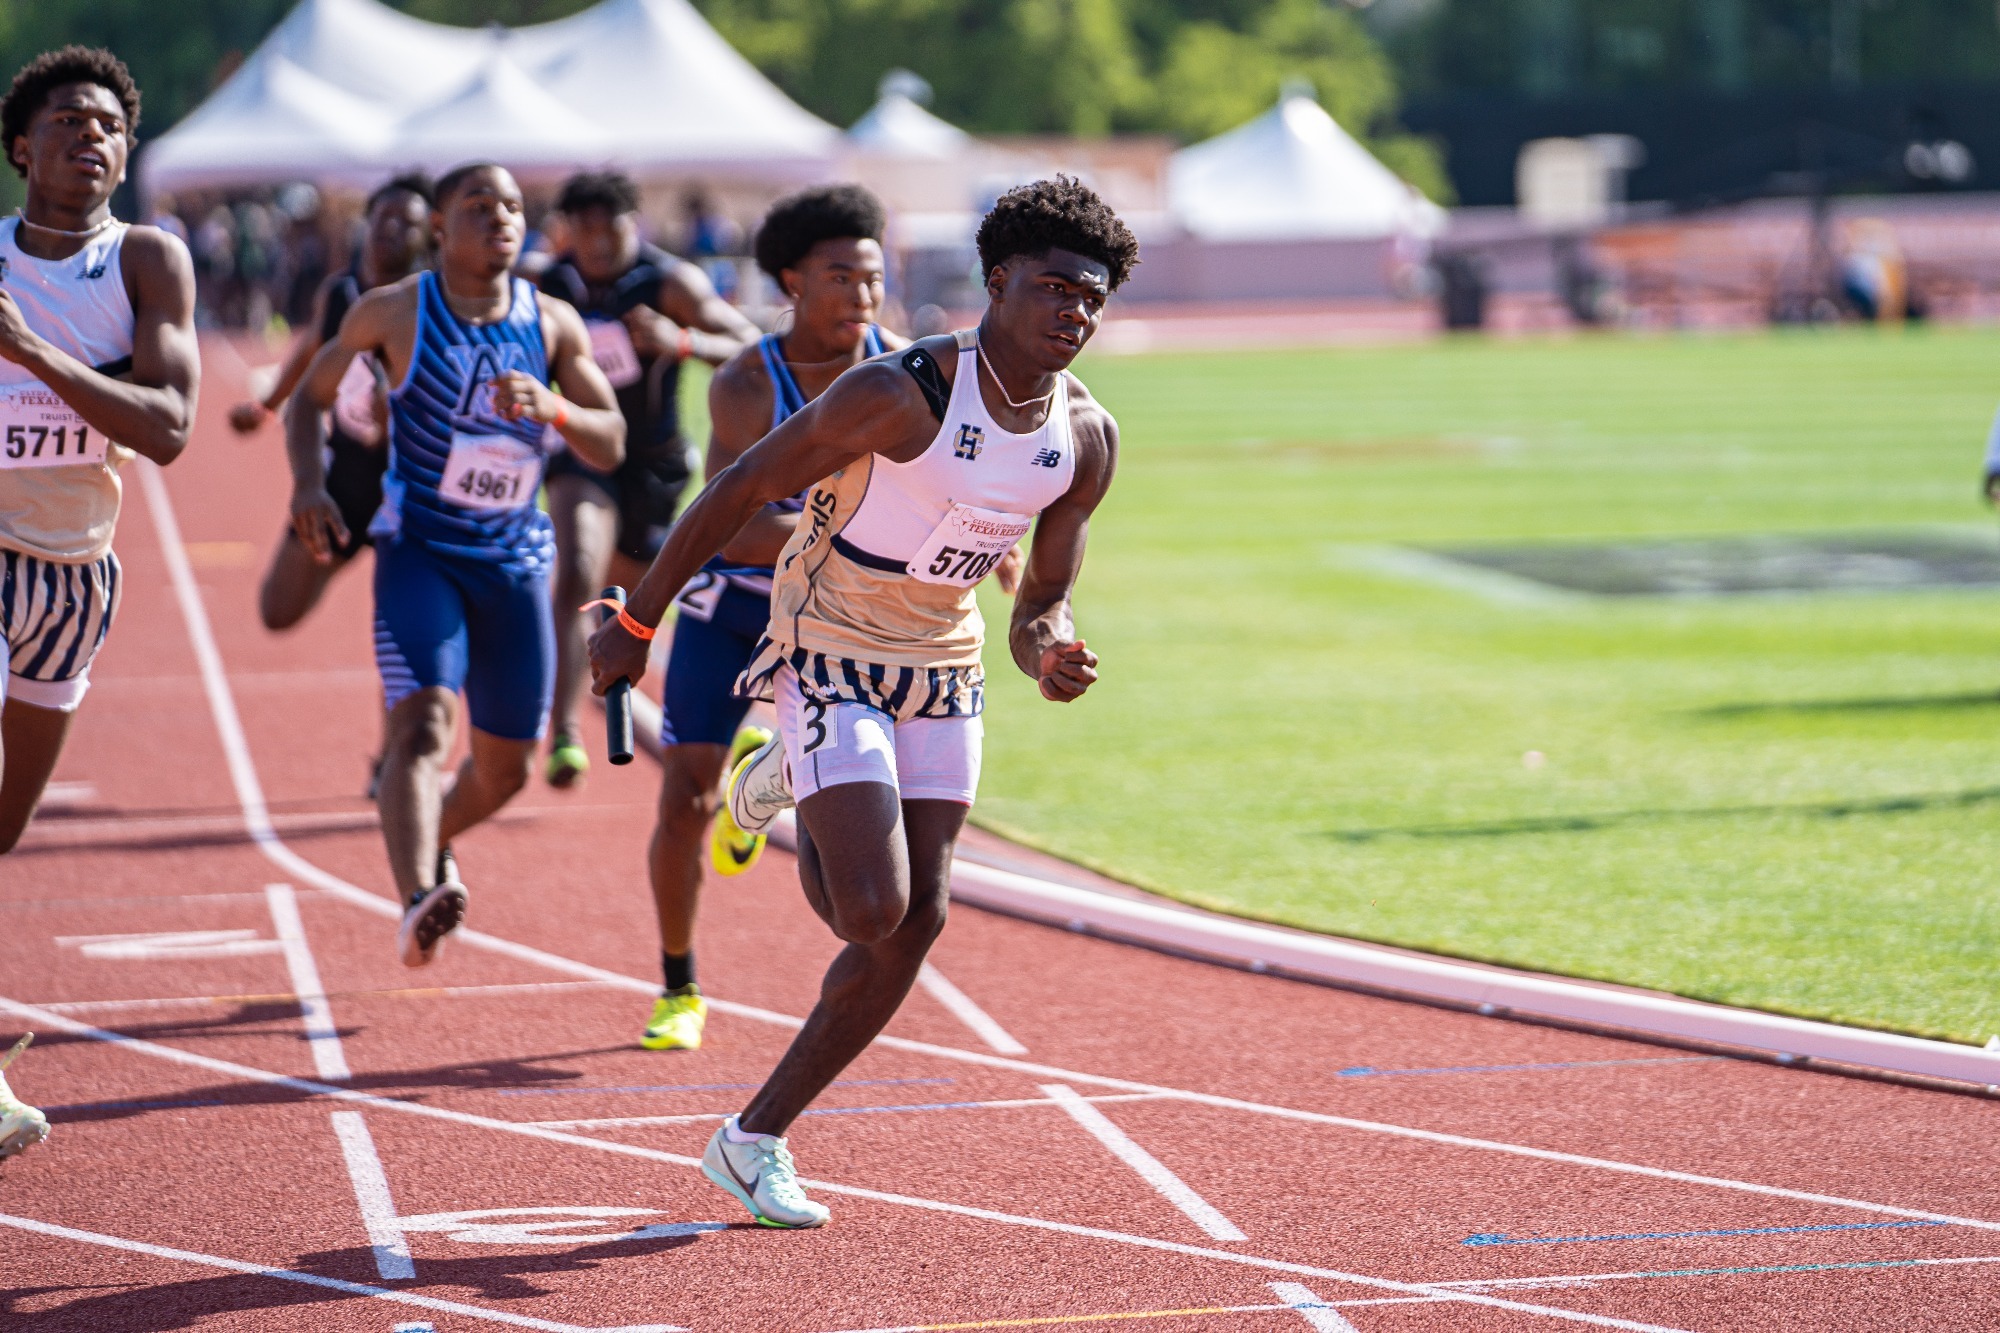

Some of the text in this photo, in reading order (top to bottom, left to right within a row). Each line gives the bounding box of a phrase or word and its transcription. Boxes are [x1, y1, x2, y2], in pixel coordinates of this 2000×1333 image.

[912, 356, 924, 369] KT
[20, 396, 60, 405] TEXAS
[40, 413, 73, 421] TRUIST
[6, 425, 88, 459] 5711
[457, 468, 521, 499] 4961
[969, 523, 999, 536] TEXAS
[972, 518, 996, 528] CLYDE
[975, 540, 999, 549] TRUIST
[928, 545, 1002, 580] 5708
[680, 571, 715, 610] 2
[803, 700, 827, 754] 3
